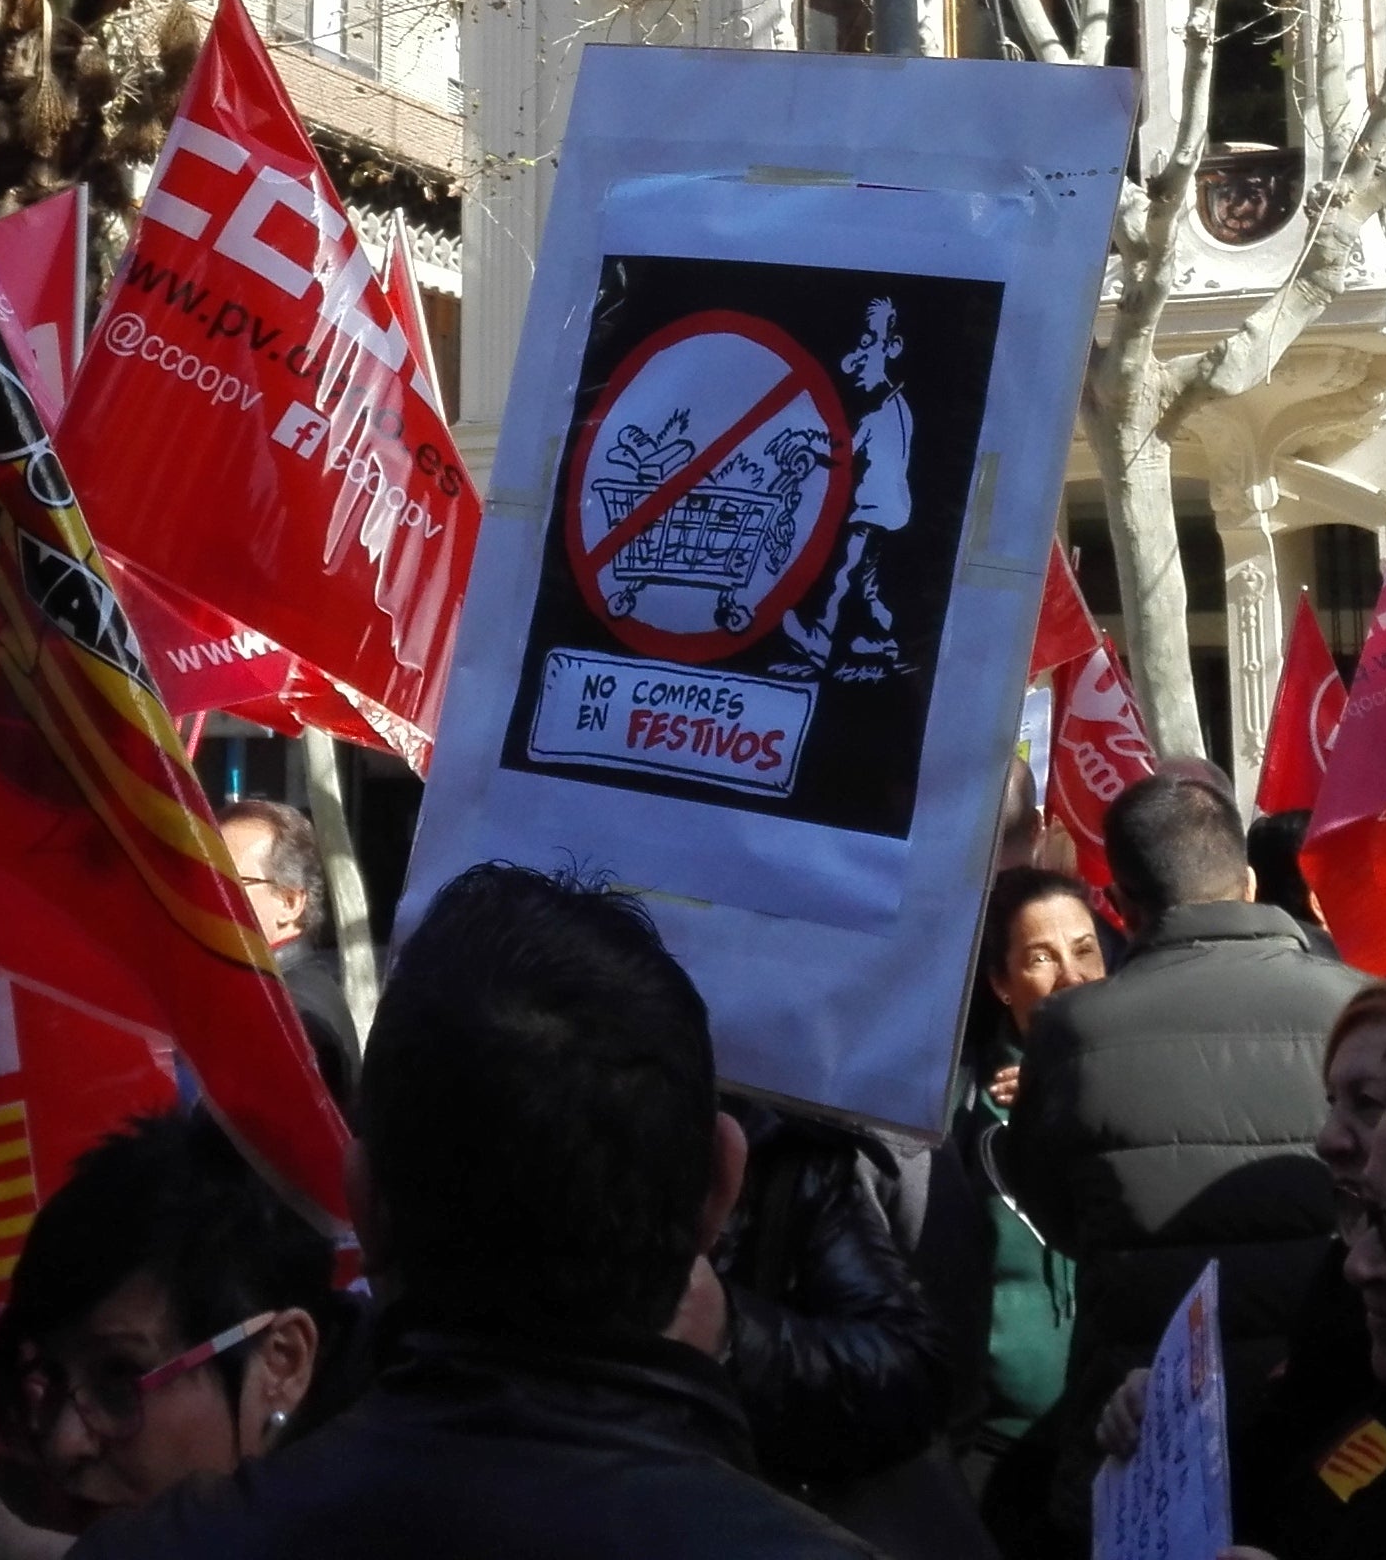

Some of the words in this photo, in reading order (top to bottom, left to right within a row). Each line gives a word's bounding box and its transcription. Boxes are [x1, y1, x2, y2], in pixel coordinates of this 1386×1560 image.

[104, 311, 263, 412] @ccoopv
[581, 673, 617, 700] NO
[631, 679, 745, 720] COMPRES
[576, 702, 610, 732] EN
[625, 708, 785, 772] FESTIVOS
